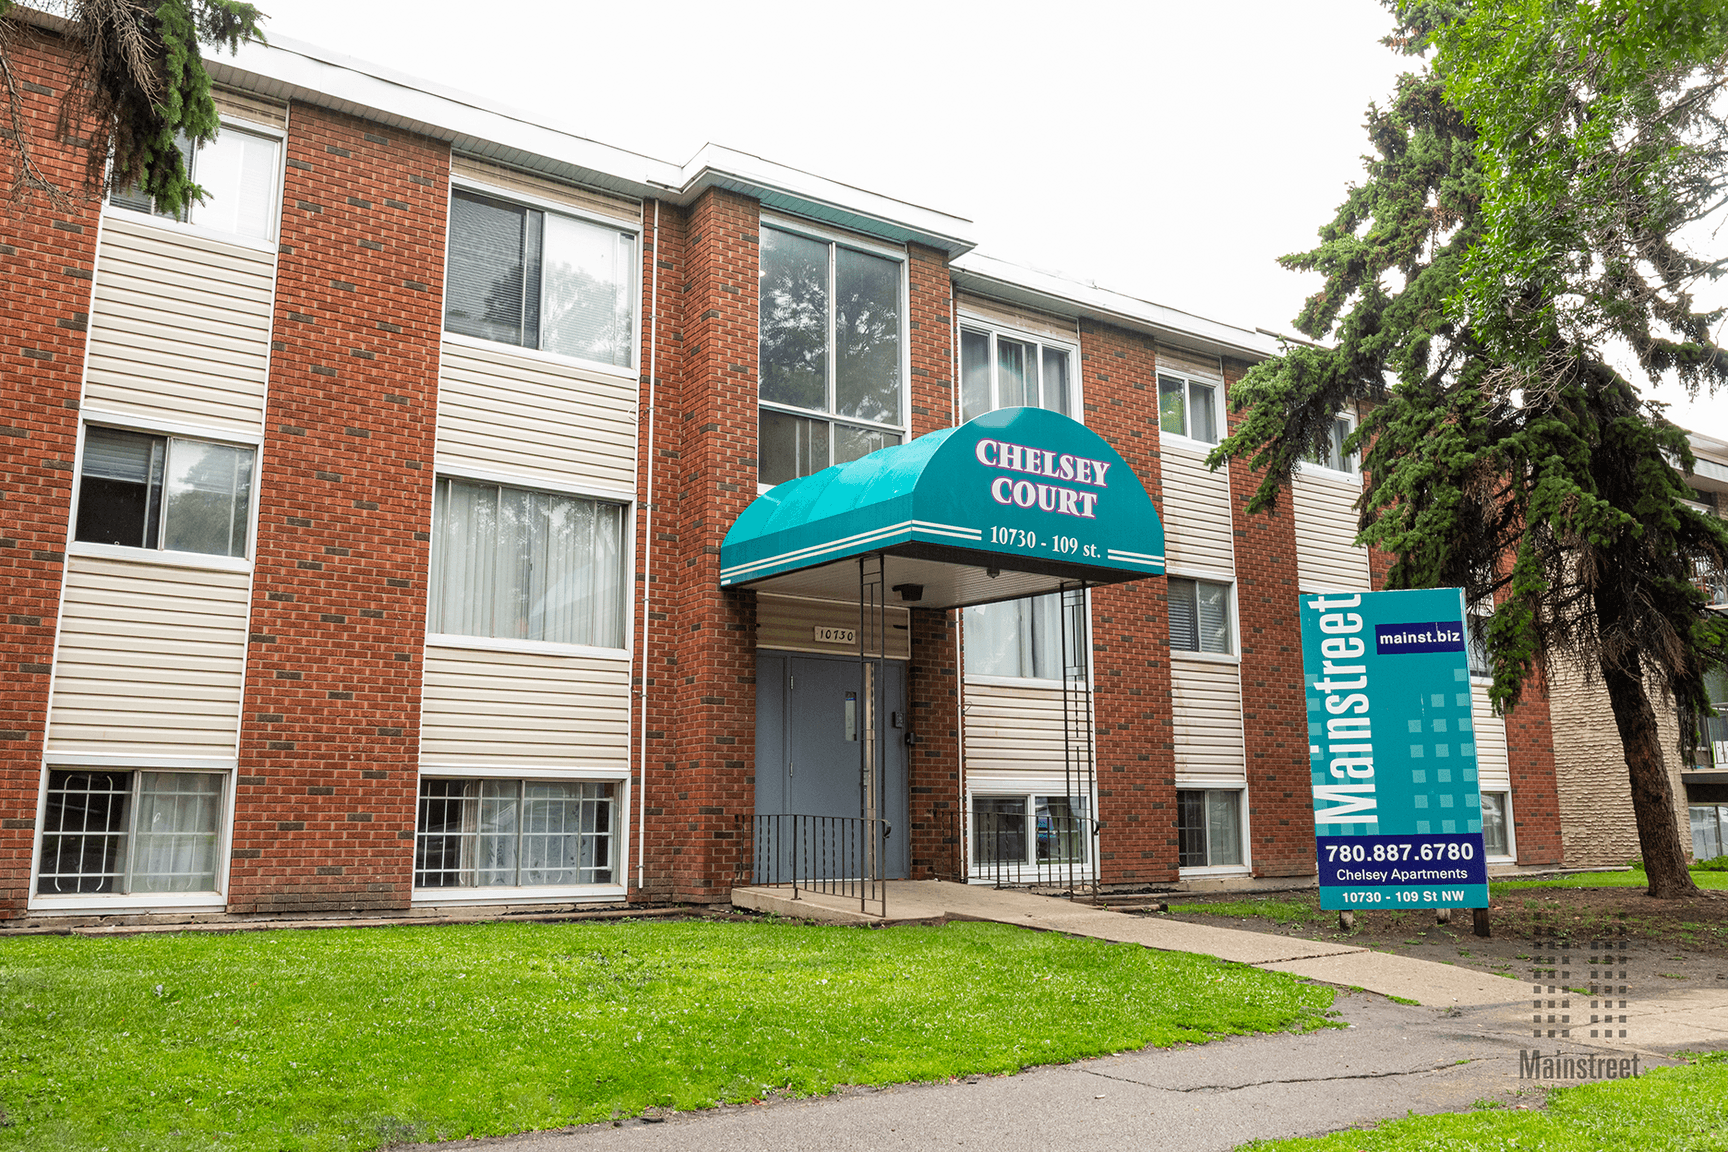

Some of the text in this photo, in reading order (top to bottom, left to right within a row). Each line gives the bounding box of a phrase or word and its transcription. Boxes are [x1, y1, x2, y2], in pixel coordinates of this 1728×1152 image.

[975, 438, 1111, 488] CHELSEY
[991, 476, 1098, 519] COURT
[990, 526, 1036, 549] 10730
[1052, 535, 1078, 555] 109
[1083, 543, 1101, 558] st.
[820, 629, 854, 641] 10730
[1379, 630, 1461, 645] mainst.biz
[1307, 593, 1379, 824] Mainstreet
[1325, 843, 1474, 862] 780.887.6780
[1336, 868, 1468, 882] Chelsey Apartments
[1342, 892, 1382, 903] 10730
[1395, 891, 1419, 902] 109
[1423, 891, 1438, 902] St
[1442, 890, 1465, 902] NW
